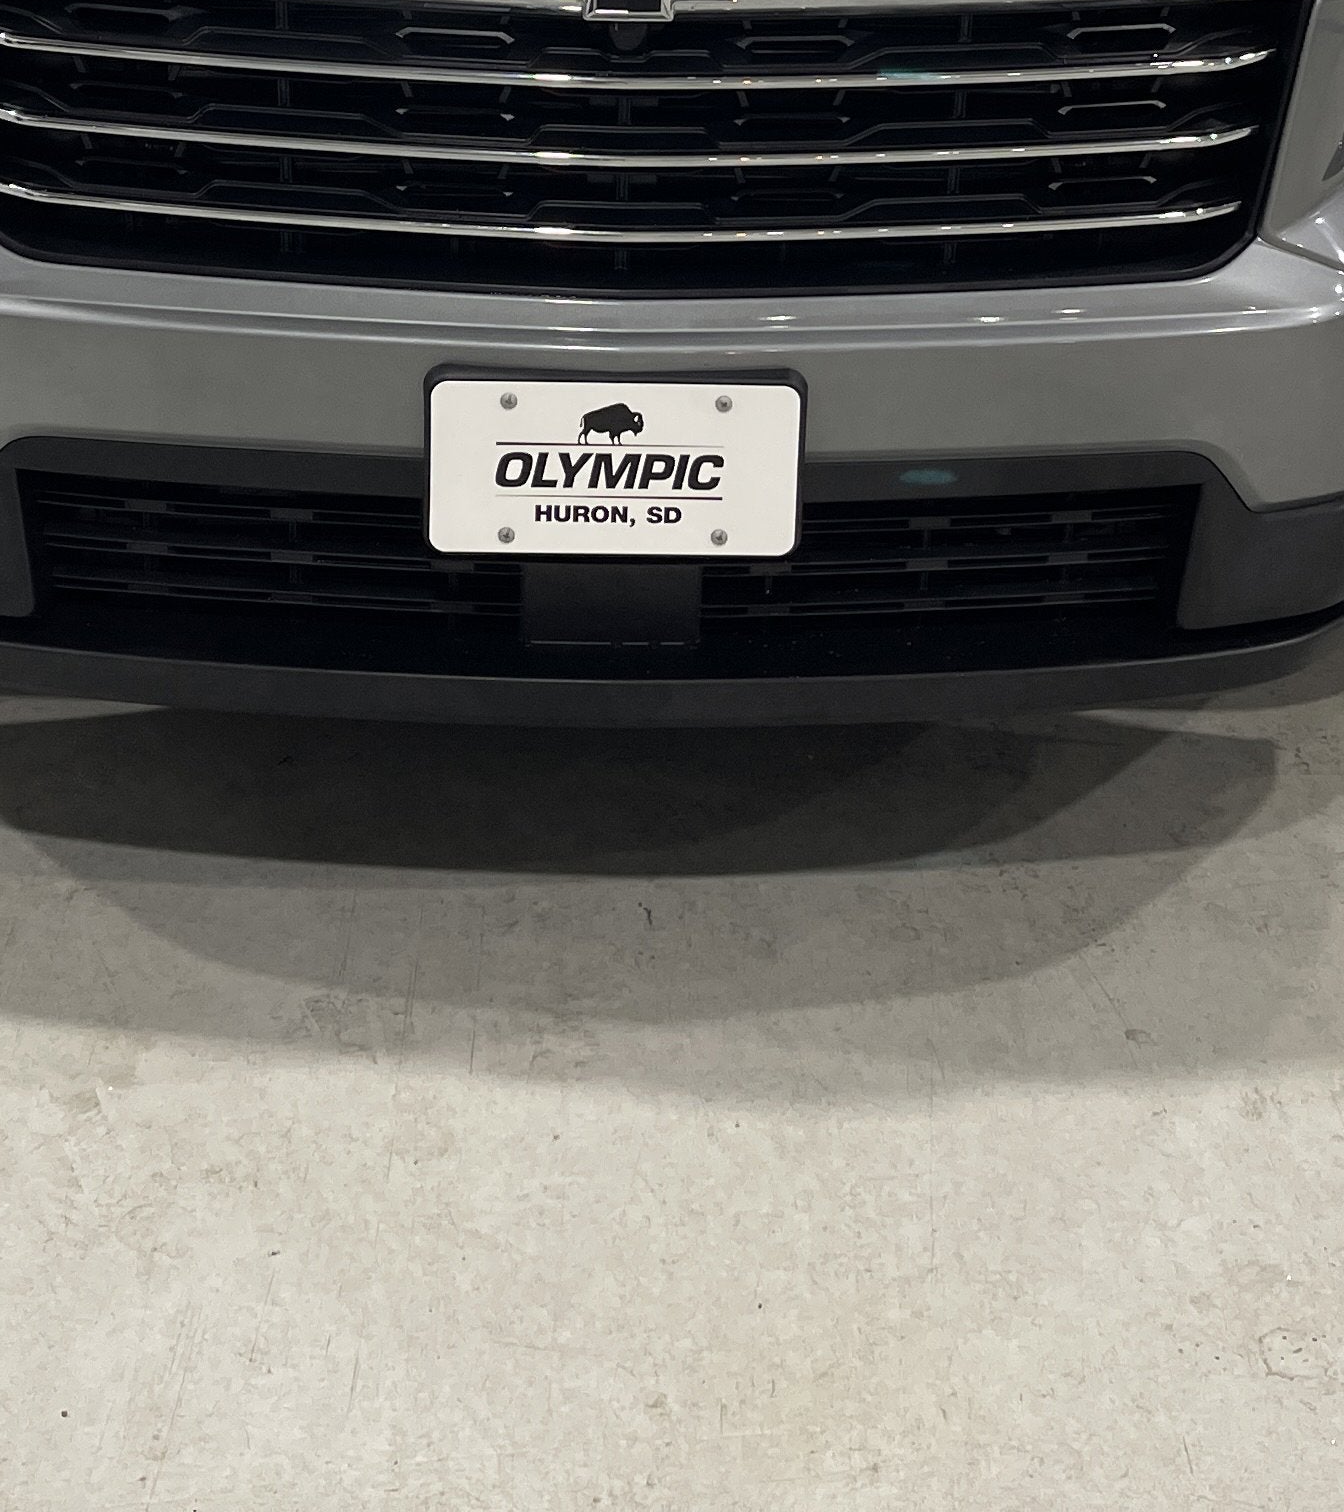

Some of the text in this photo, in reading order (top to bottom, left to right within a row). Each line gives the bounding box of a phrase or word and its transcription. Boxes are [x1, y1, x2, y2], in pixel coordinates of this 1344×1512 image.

[495, 451, 724, 491] OLYMPIC
[535, 504, 682, 528] HURON, SD
